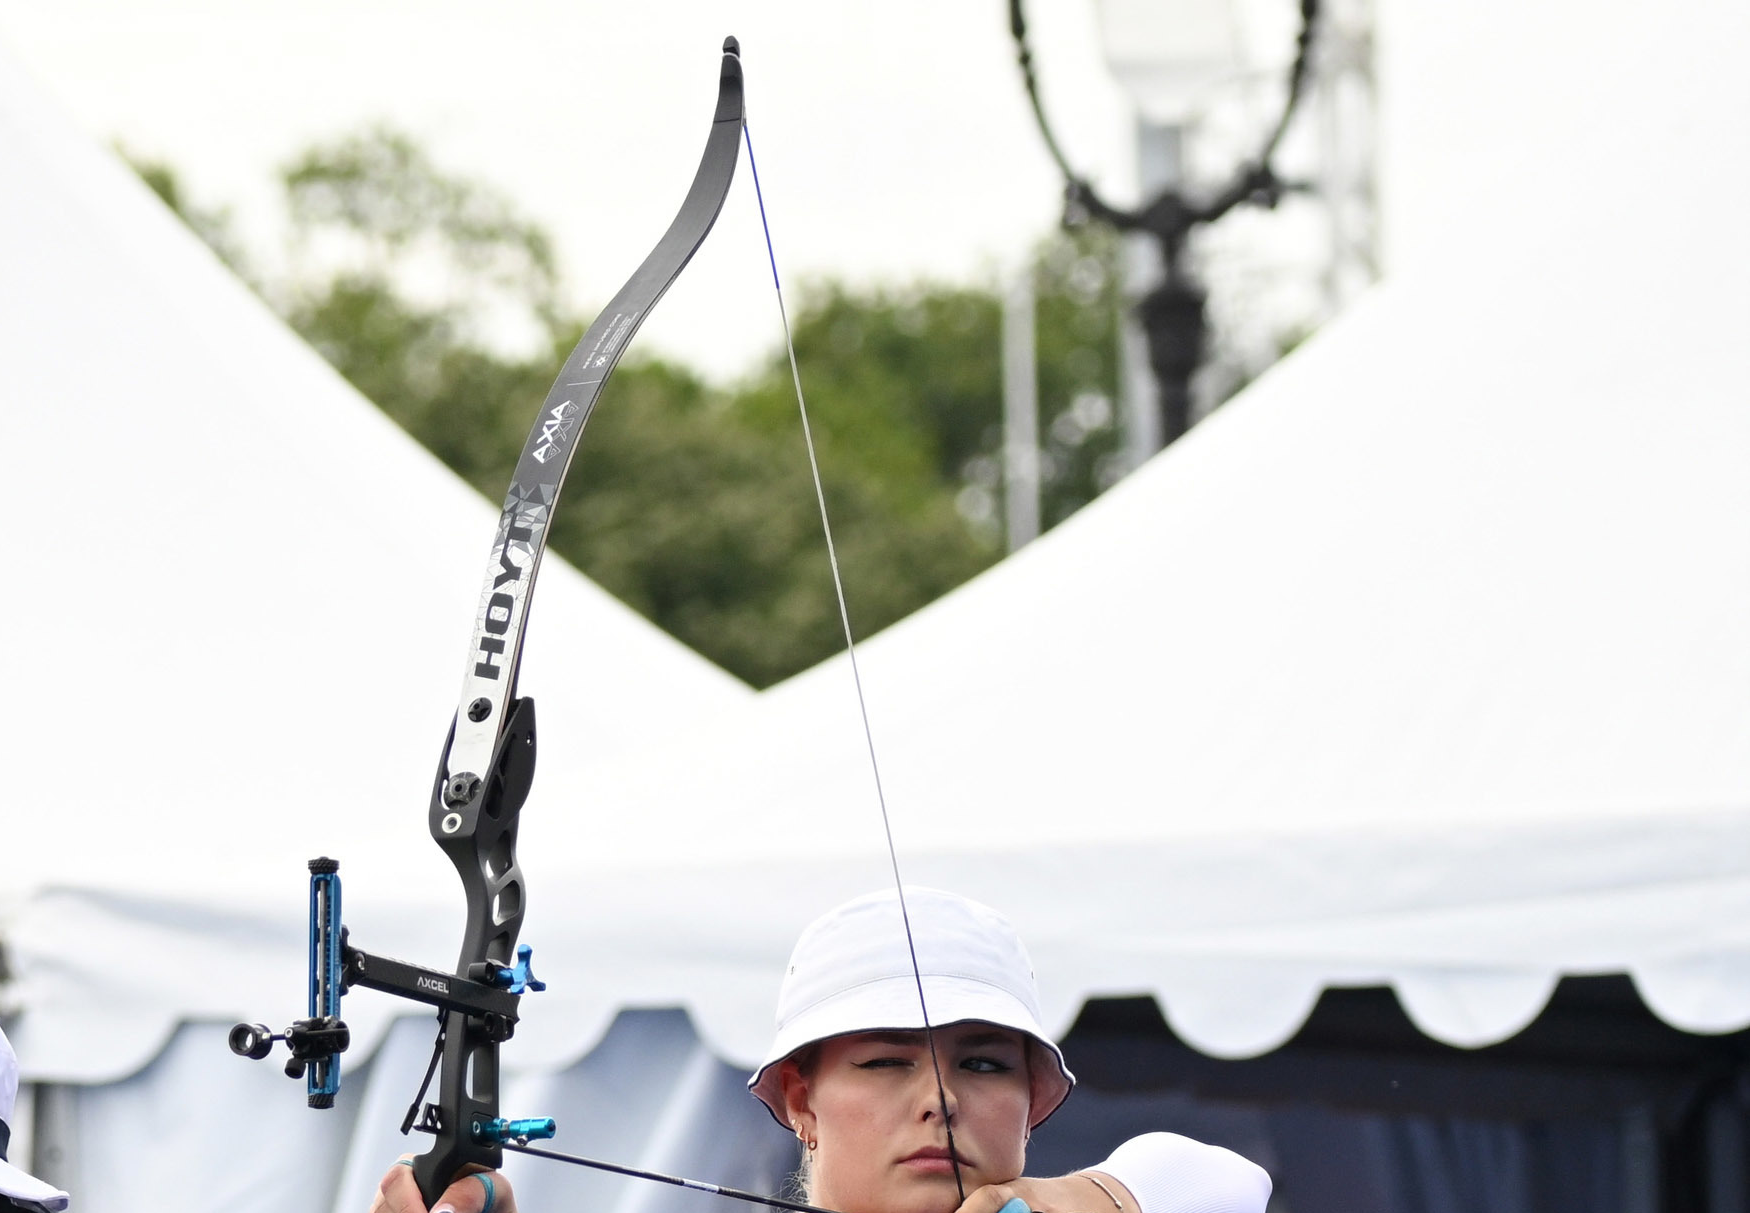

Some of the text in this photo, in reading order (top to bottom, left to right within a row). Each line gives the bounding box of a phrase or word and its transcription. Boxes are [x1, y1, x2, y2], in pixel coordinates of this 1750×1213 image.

[532, 400, 575, 464] AXIA
[474, 513, 533, 681] HOYT
[417, 976, 449, 994] AXCEL
